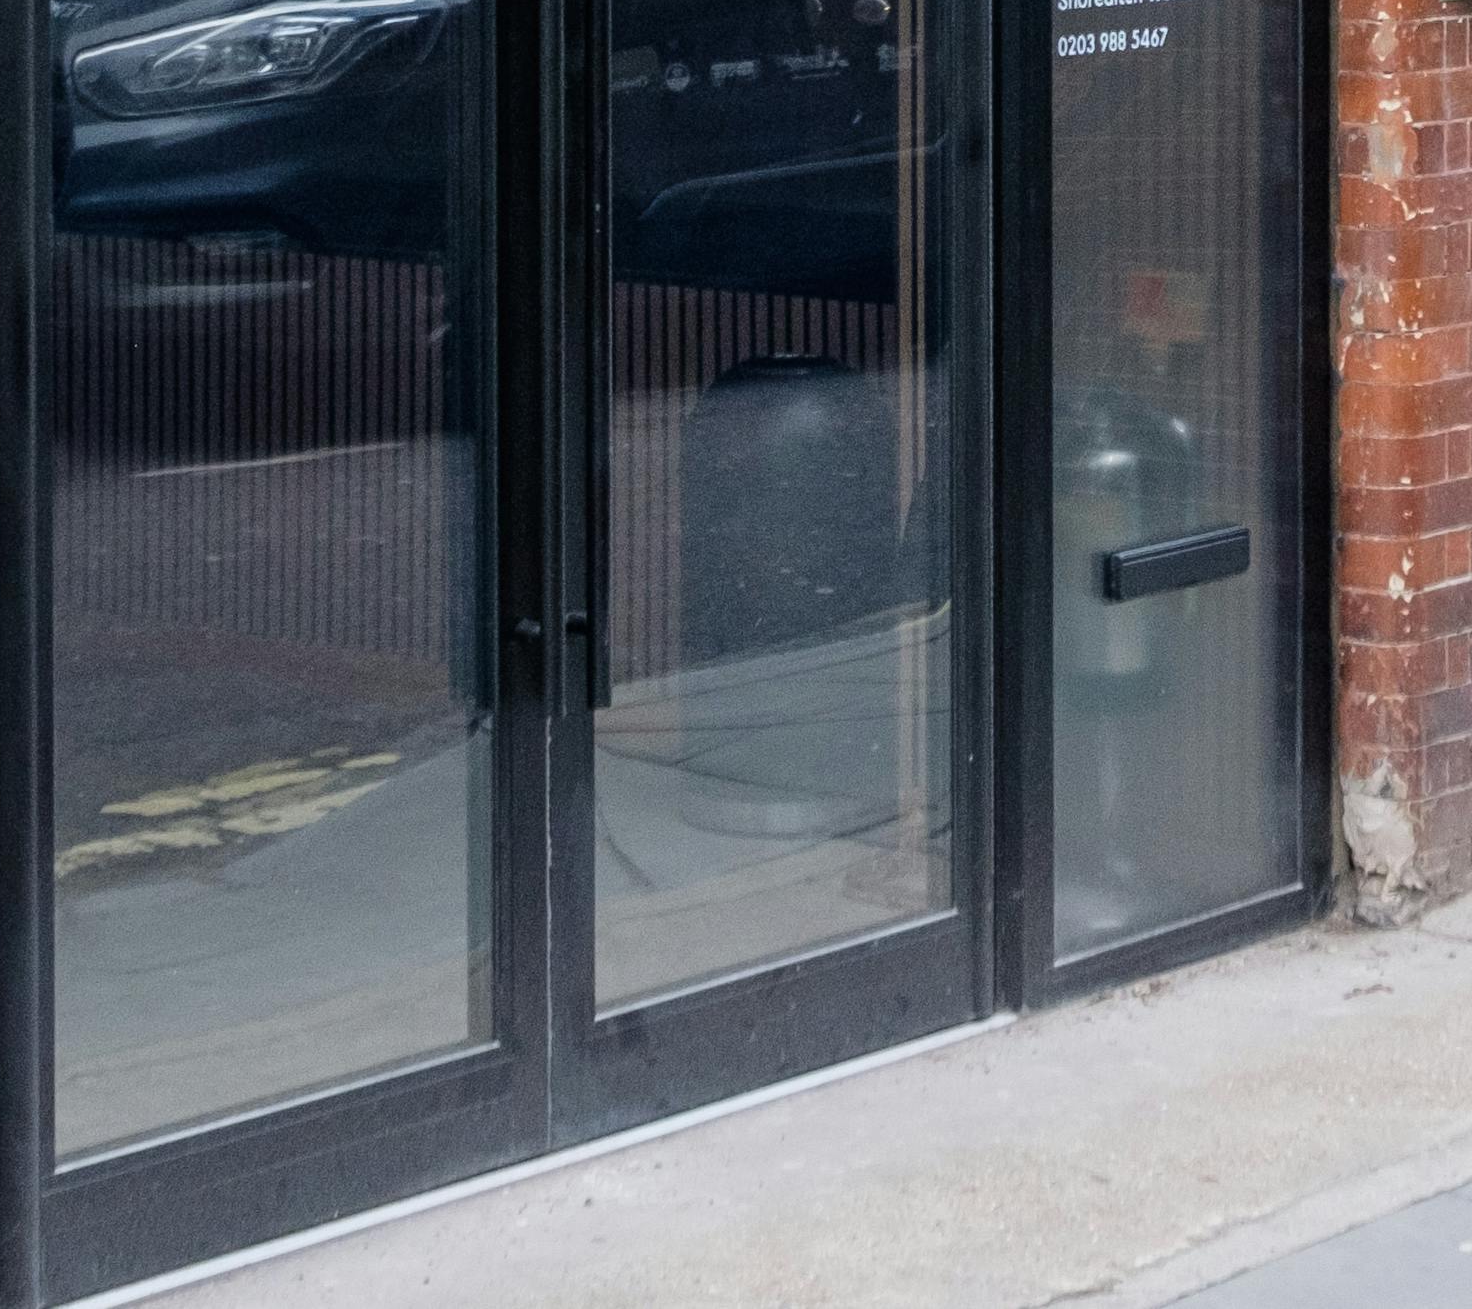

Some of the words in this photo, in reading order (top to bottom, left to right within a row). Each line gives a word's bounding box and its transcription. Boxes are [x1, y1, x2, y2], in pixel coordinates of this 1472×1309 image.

[1058, 34, 1095, 57] 0203
[1100, 31, 1126, 53] 988
[1130, 27, 1169, 50] 5467
